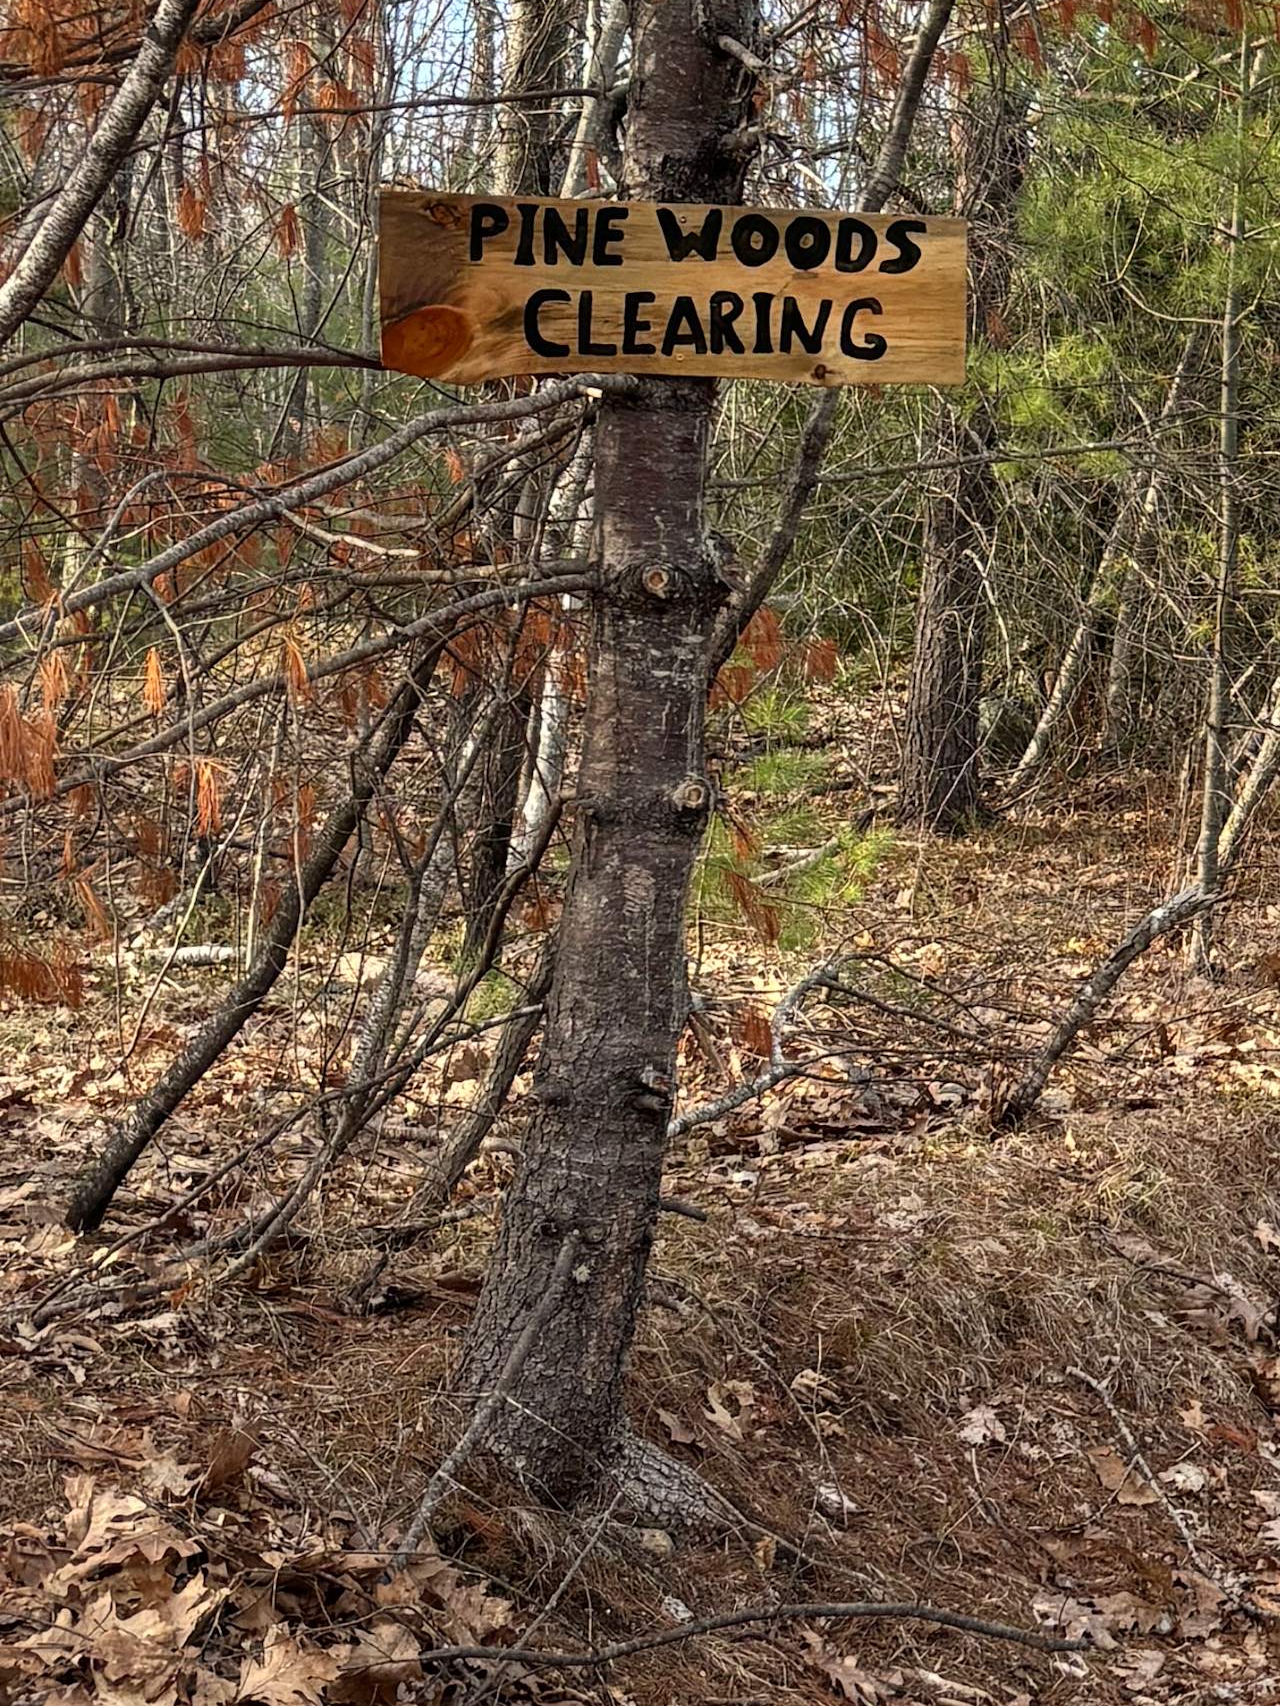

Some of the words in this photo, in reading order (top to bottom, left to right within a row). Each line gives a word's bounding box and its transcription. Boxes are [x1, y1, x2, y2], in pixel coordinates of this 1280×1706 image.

[468, 202, 629, 267] PINE
[656, 207, 928, 275] WOODS
[523, 288, 888, 361] CLEARING
